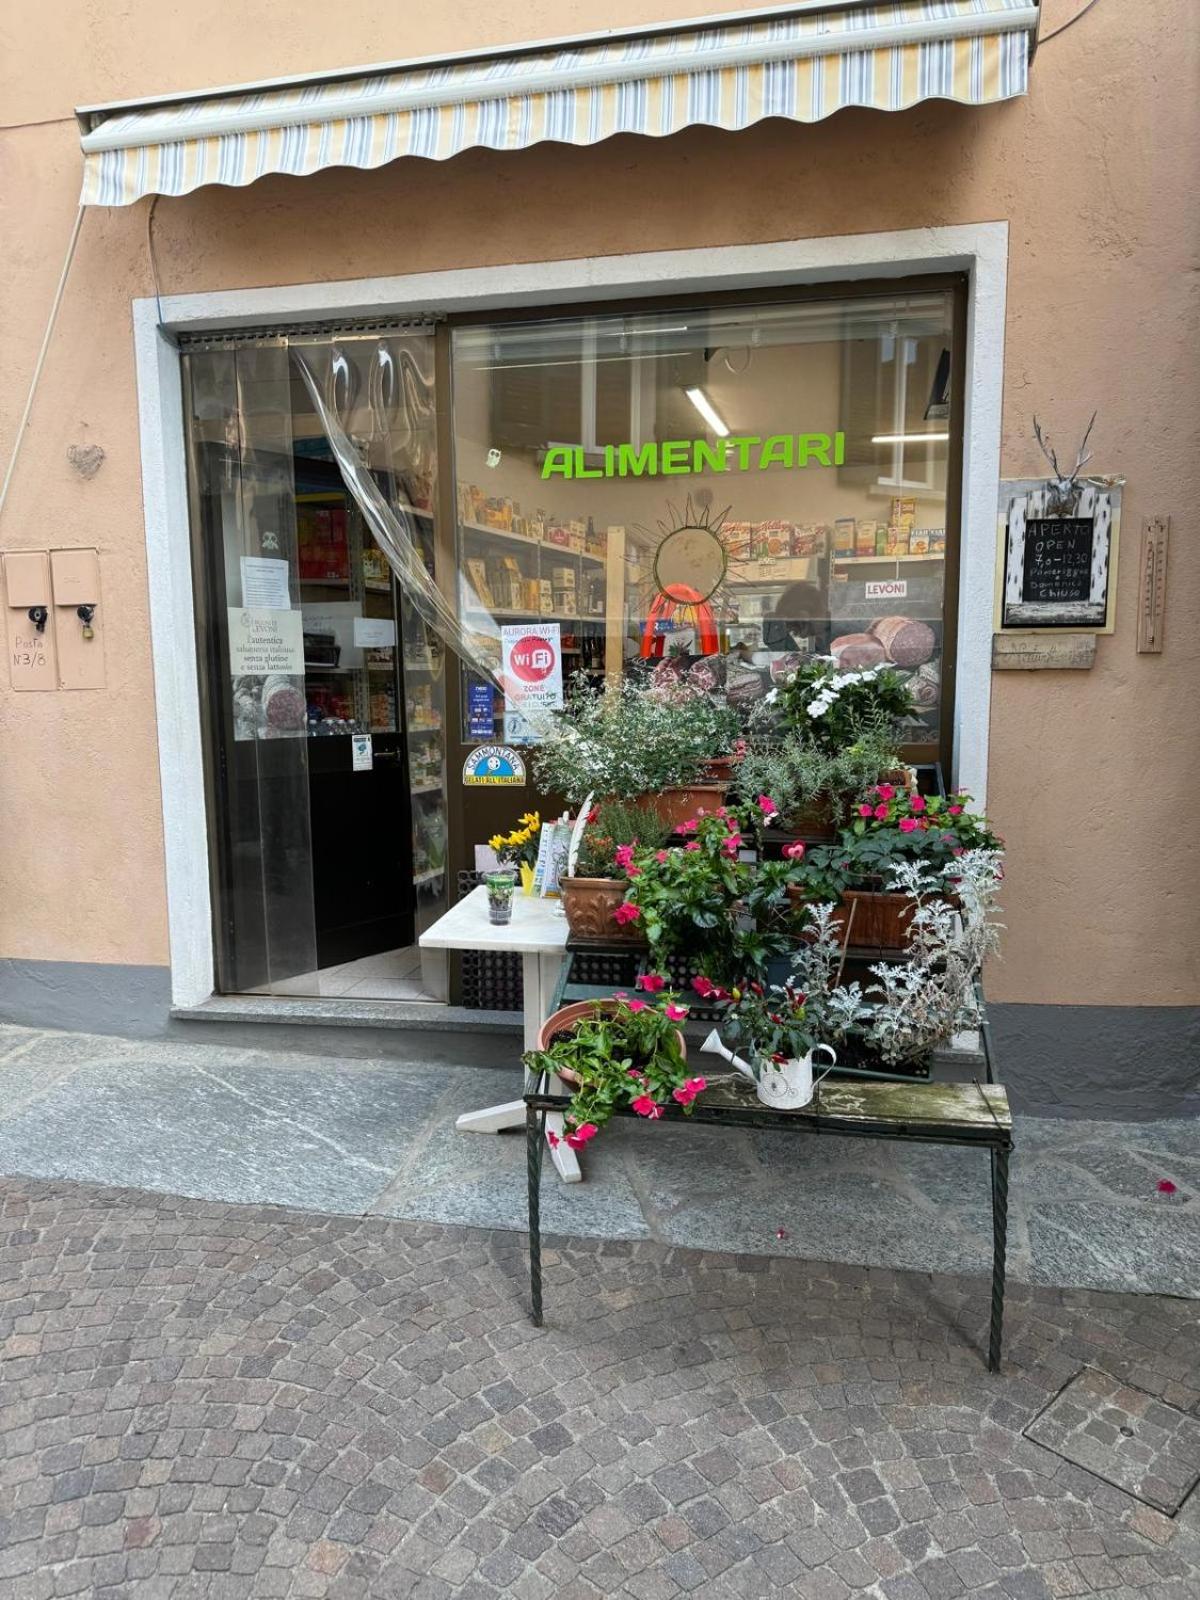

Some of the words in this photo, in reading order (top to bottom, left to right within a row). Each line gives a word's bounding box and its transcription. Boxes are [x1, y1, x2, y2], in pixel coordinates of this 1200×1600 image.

[541, 431, 846, 480] ALIMENTARI
[1035, 540, 1076, 552] OPEN
[867, 582, 905, 595] LEVONI
[503, 627, 538, 636] AURORA
[467, 745, 519, 770] SAMMONTANA
